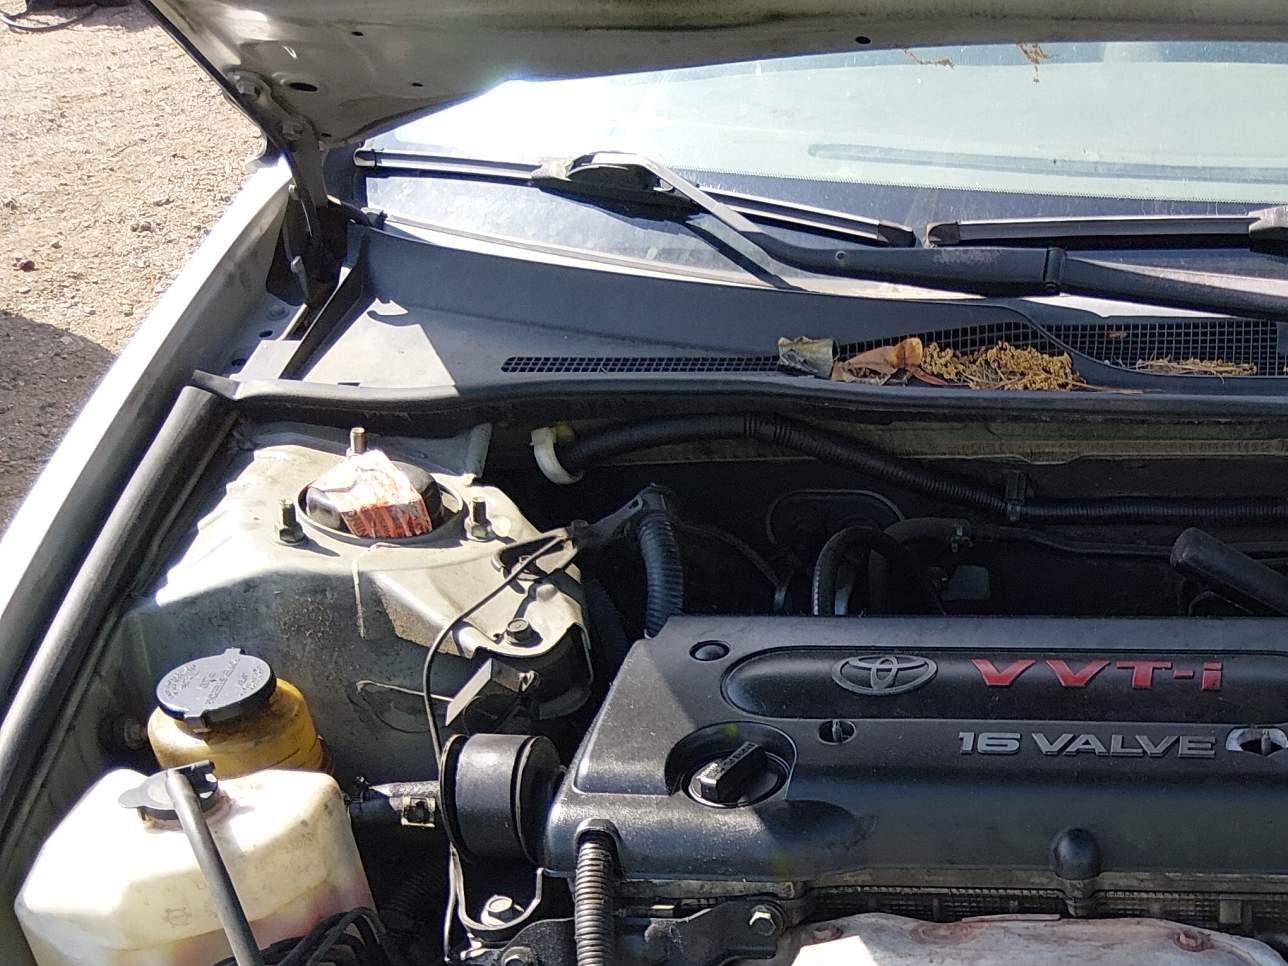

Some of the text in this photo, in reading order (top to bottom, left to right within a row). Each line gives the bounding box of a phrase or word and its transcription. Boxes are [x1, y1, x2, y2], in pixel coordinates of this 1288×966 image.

[970, 657, 1224, 692] VVT-i
[958, 731, 1218, 759] 16 VALVE
